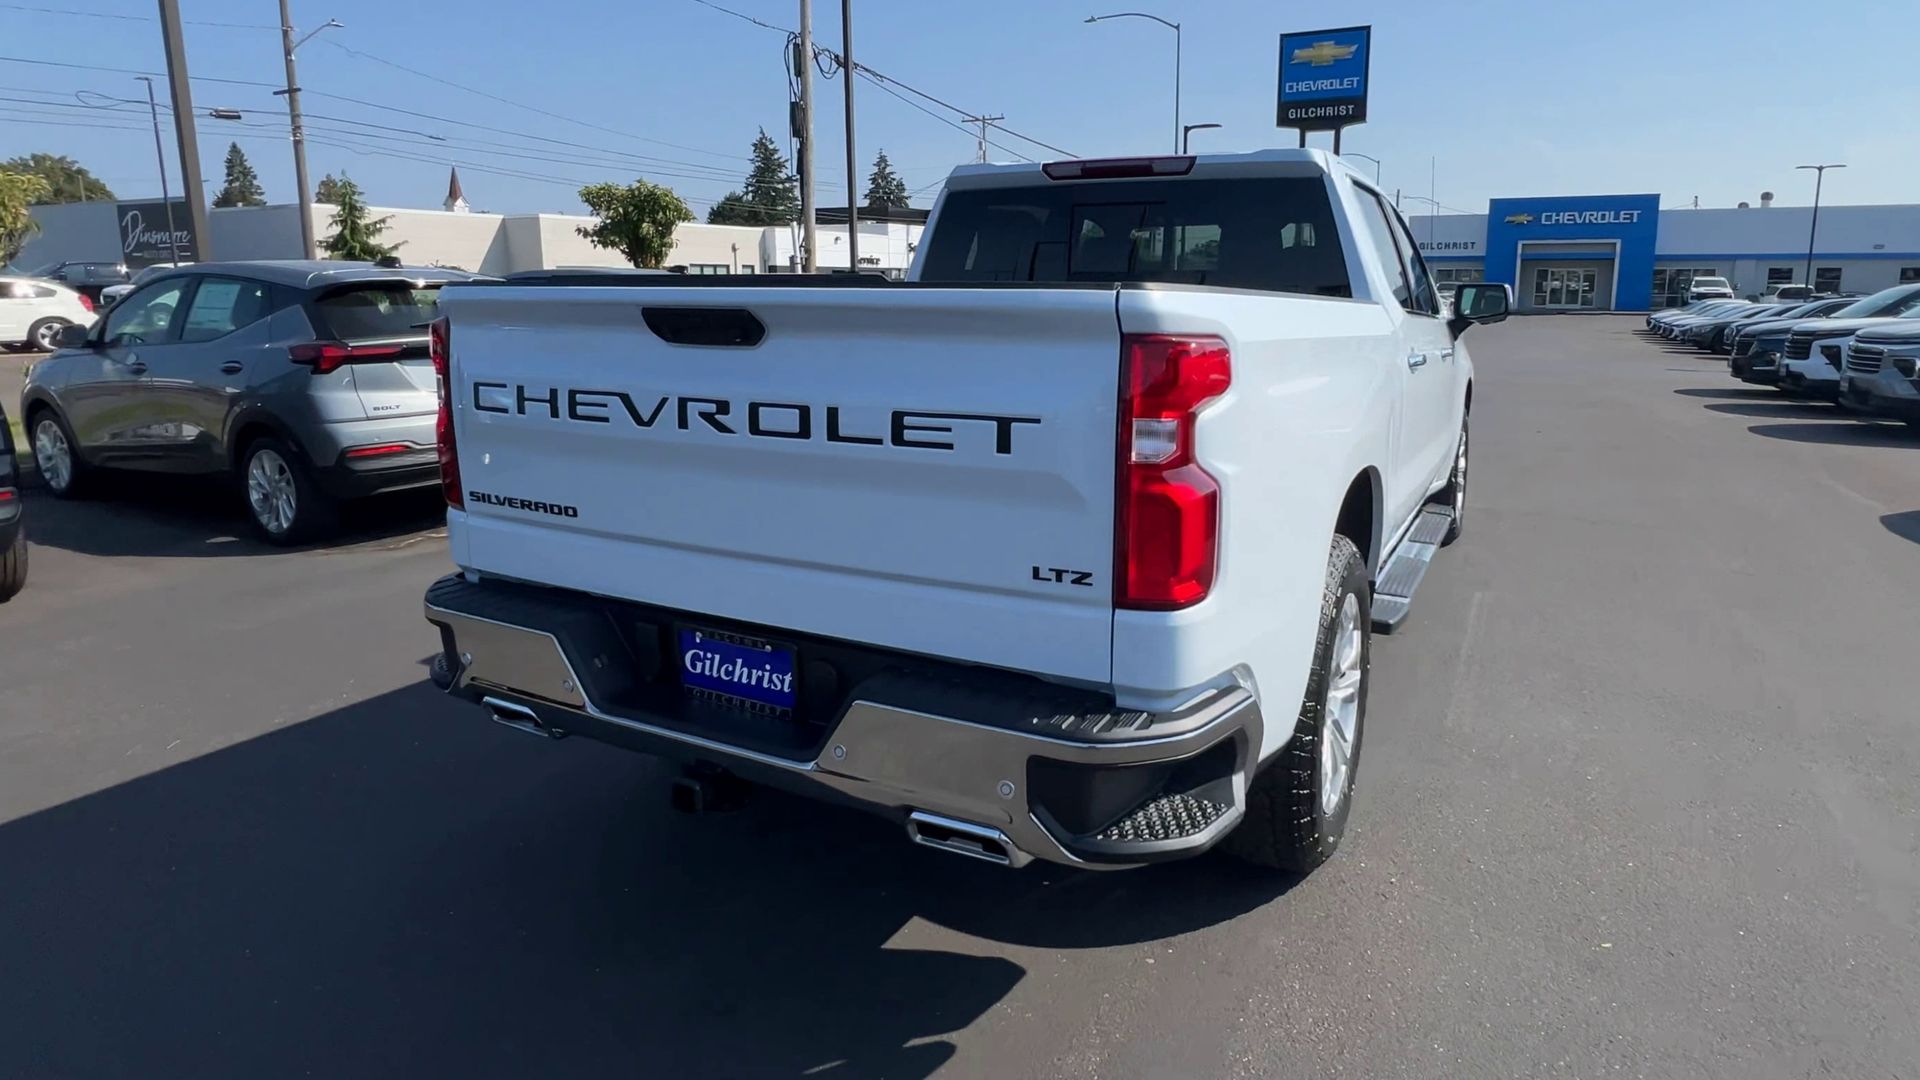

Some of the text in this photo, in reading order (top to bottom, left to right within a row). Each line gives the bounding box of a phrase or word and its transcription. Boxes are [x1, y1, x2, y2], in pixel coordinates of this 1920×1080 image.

[1285, 77, 1360, 93] CHEVROLET
[1288, 105, 1355, 119] GILCHRIST
[1541, 210, 1642, 225] CHEVROLET
[1419, 241, 1477, 250] GILCHRIST
[857, 254, 881, 265] ervice
[372, 404, 401, 412] BOLT
[473, 382, 1042, 454] CHEVROLET
[469, 490, 578, 518] SILVERADO
[1032, 566, 1094, 587] LTZ
[684, 649, 793, 693] Gilchrist
[693, 687, 781, 718] GILCHRIST
